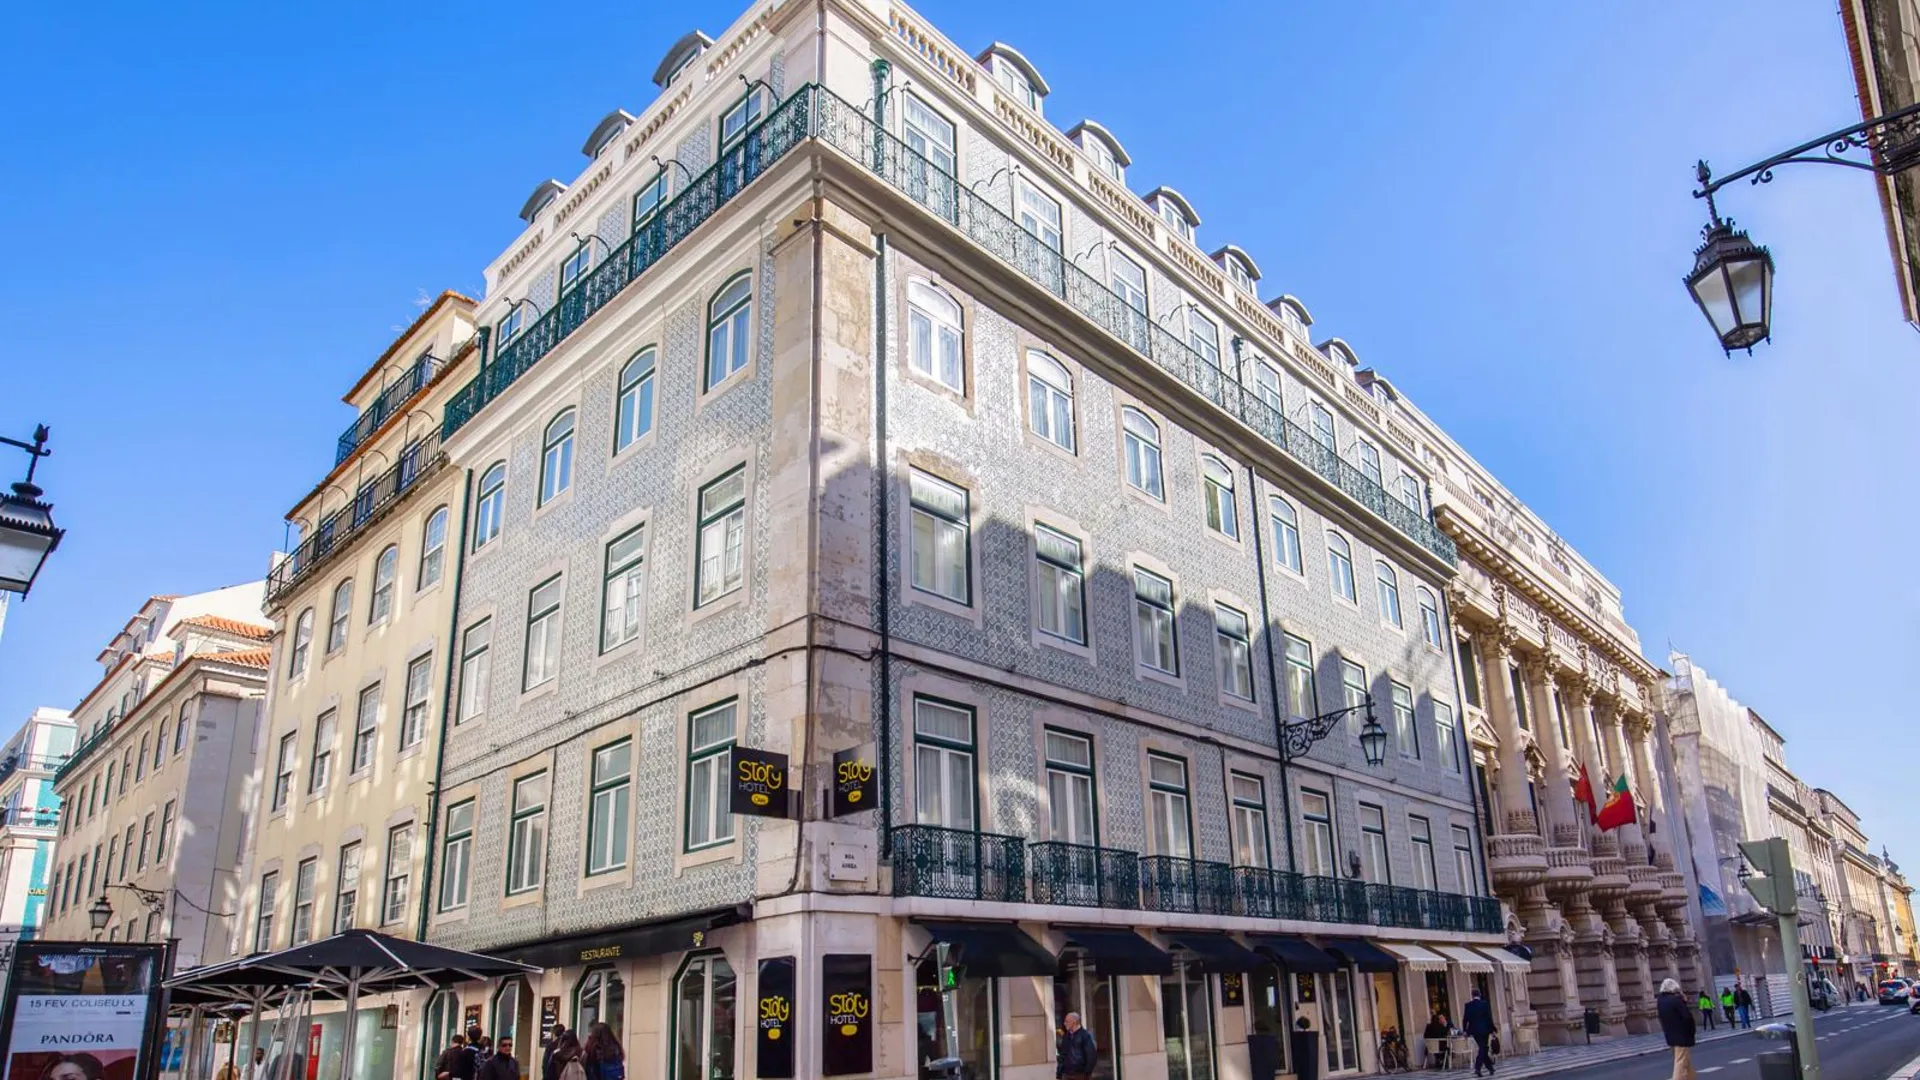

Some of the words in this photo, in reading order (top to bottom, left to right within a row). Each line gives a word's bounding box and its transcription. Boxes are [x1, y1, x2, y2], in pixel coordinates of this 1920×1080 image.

[738, 782, 770, 794] HOTEL
[581, 945, 621, 961] RESTAURANTE
[30, 1000, 42, 1008] 15
[71, 999, 120, 1008] COLISEU
[121, 999, 135, 1007] LX
[760, 1018, 782, 1029] HOTEL
[830, 1014, 859, 1025] HOTEL
